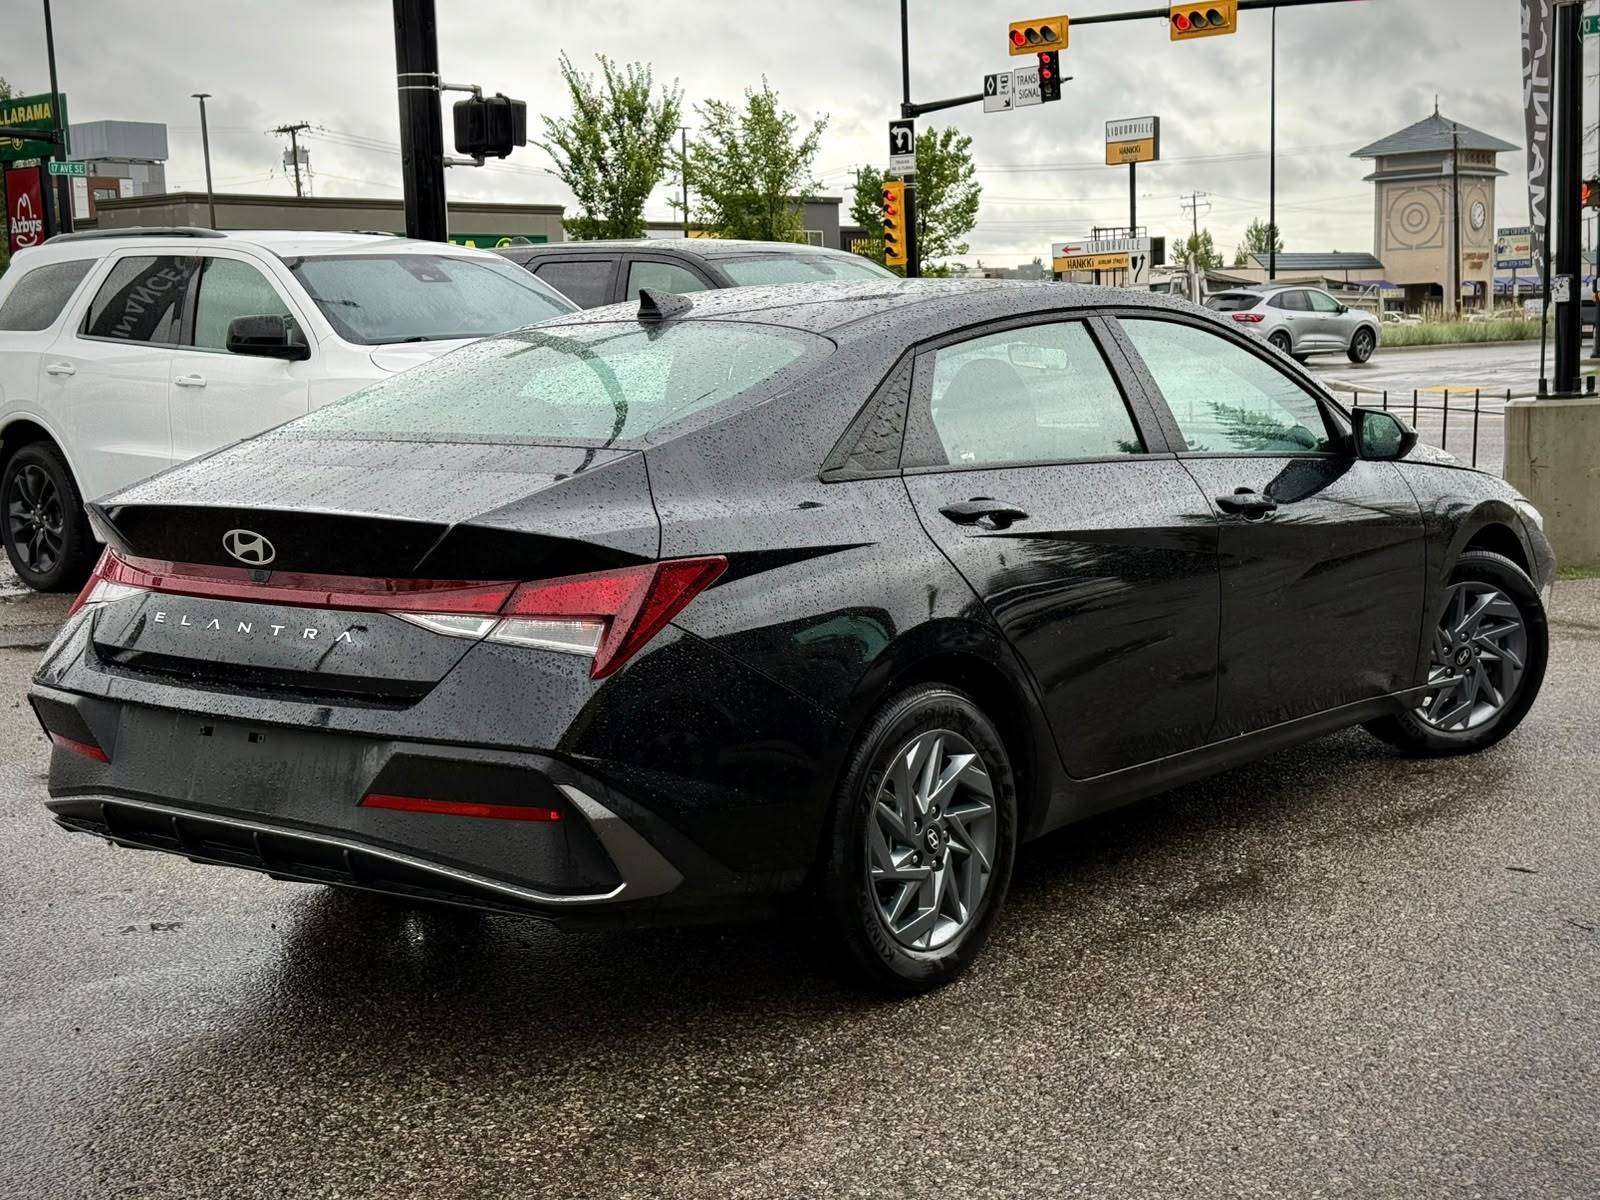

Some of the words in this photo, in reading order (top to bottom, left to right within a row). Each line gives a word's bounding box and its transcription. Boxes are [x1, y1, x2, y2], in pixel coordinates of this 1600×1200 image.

[1016, 73, 1040, 86] TRANSI
[1018, 87, 1041, 100] SIGNAL
[1107, 122, 1154, 138] LIQUORVILLE
[51, 163, 58, 173] 17
[60, 164, 73, 173] AVE
[74, 164, 84, 174] SE
[11, 213, 42, 236] Arby's
[1086, 239, 1141, 254] LIQUORVILLE
[154, 610, 353, 643] ELANTRA
